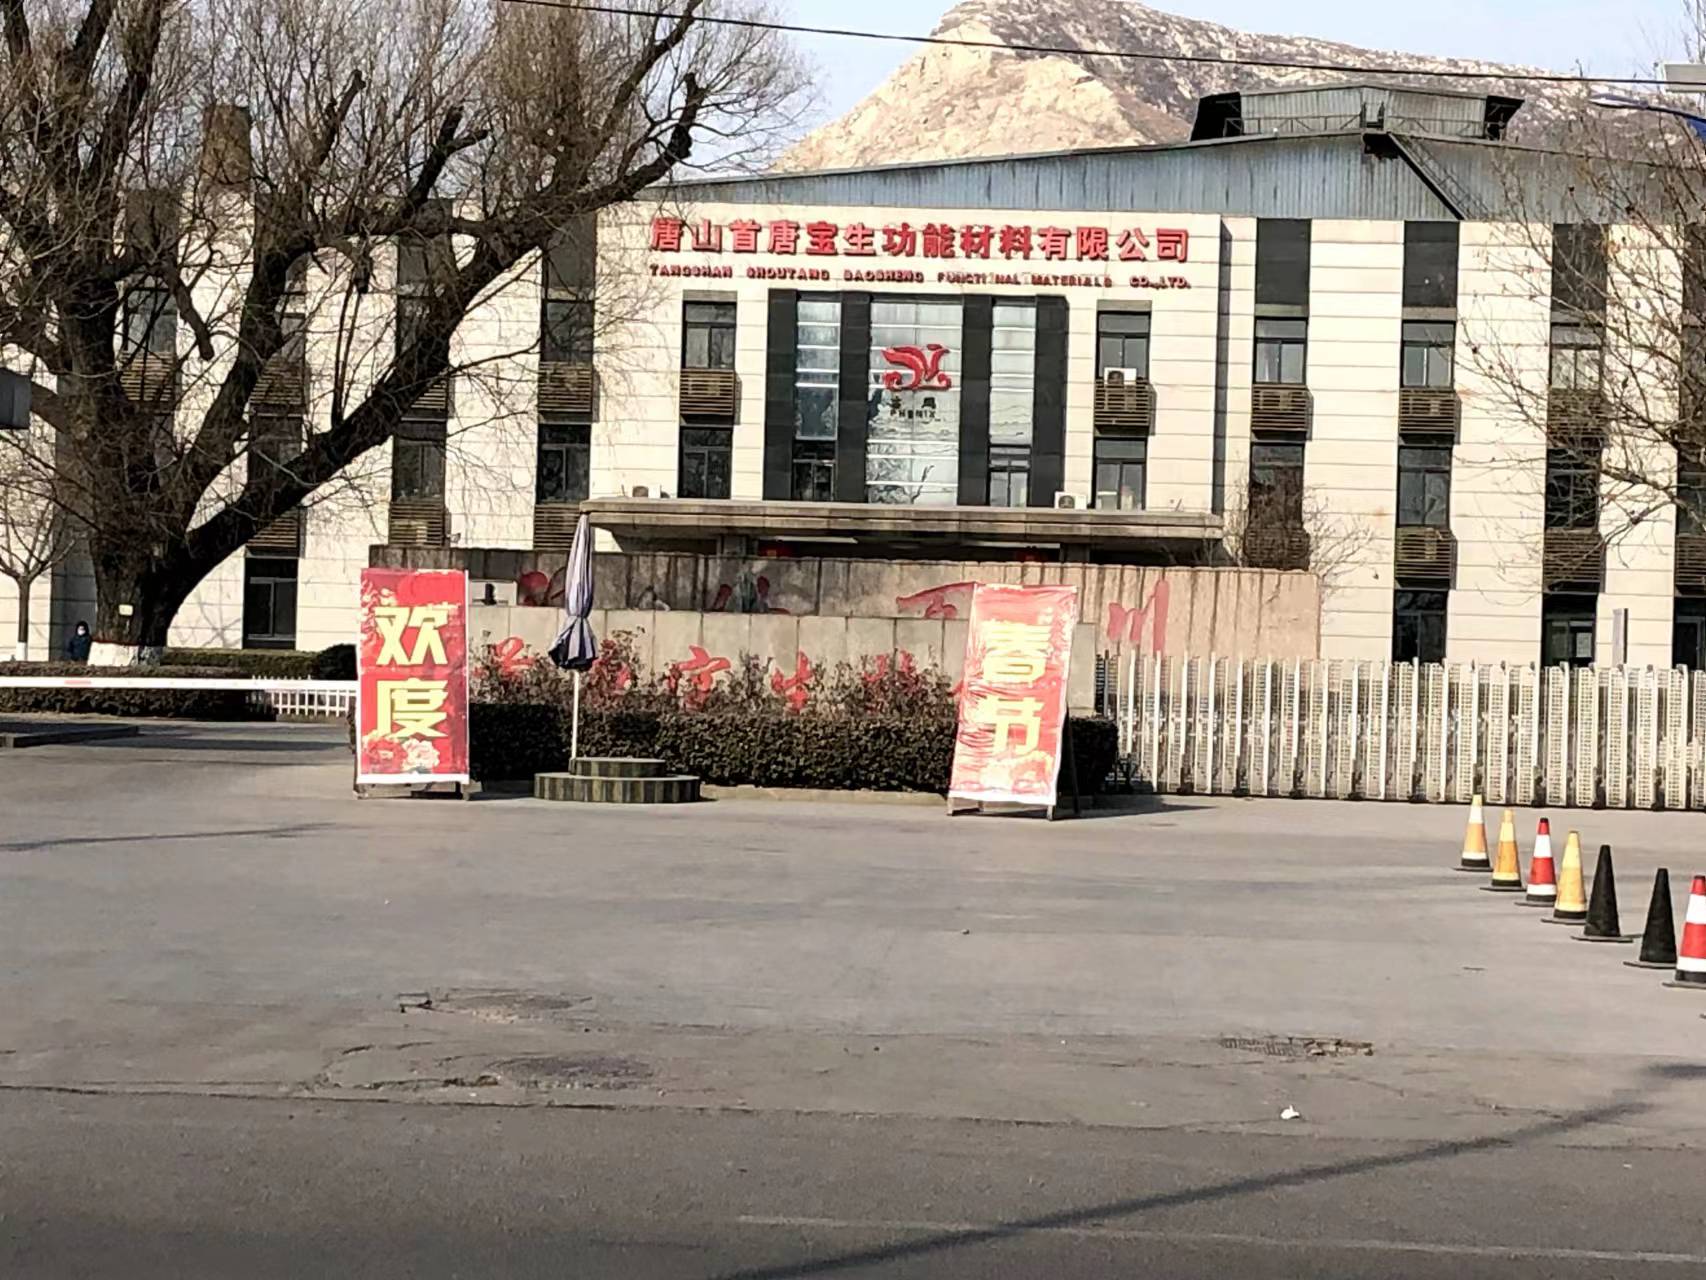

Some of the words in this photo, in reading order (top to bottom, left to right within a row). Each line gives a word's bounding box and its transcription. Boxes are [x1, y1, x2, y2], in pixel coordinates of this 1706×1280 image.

[649, 263, 733, 278] TANGSHAN
[746, 266, 830, 281] SHOUTANG
[843, 269, 924, 284] BAOSHENG
[937, 271, 1021, 285] FUNCTINAL
[1031, 274, 1112, 288] MATERIALS
[650, 217, 1189, 262] 唐山首唐宝生功能材料有限公司
[374, 605, 449, 738] 欢度
[976, 621, 1051, 755] 春节
